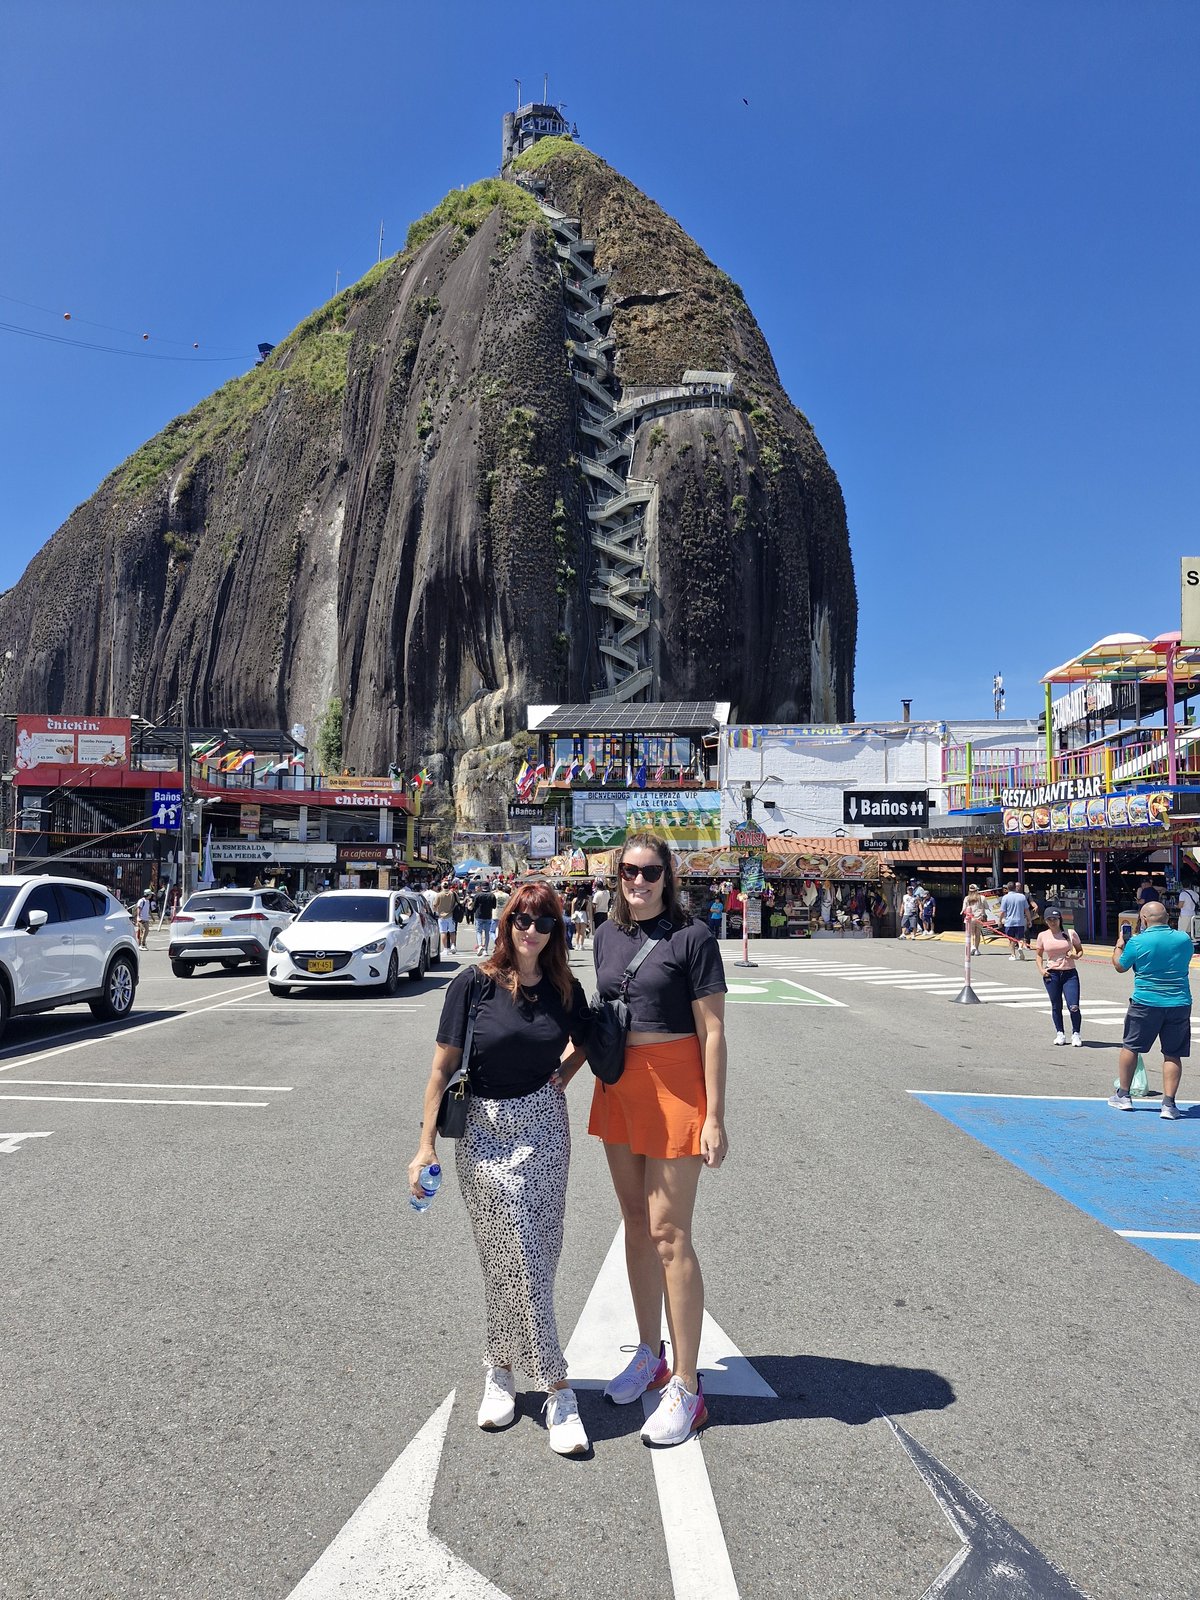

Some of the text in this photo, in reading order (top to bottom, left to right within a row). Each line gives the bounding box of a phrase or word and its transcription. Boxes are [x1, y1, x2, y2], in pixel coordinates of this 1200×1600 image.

[154, 791, 181, 801] Baños
[515, 807, 537, 815] Baños
[861, 799, 908, 815] Baños
[340, 849, 382, 860] La cafetería
